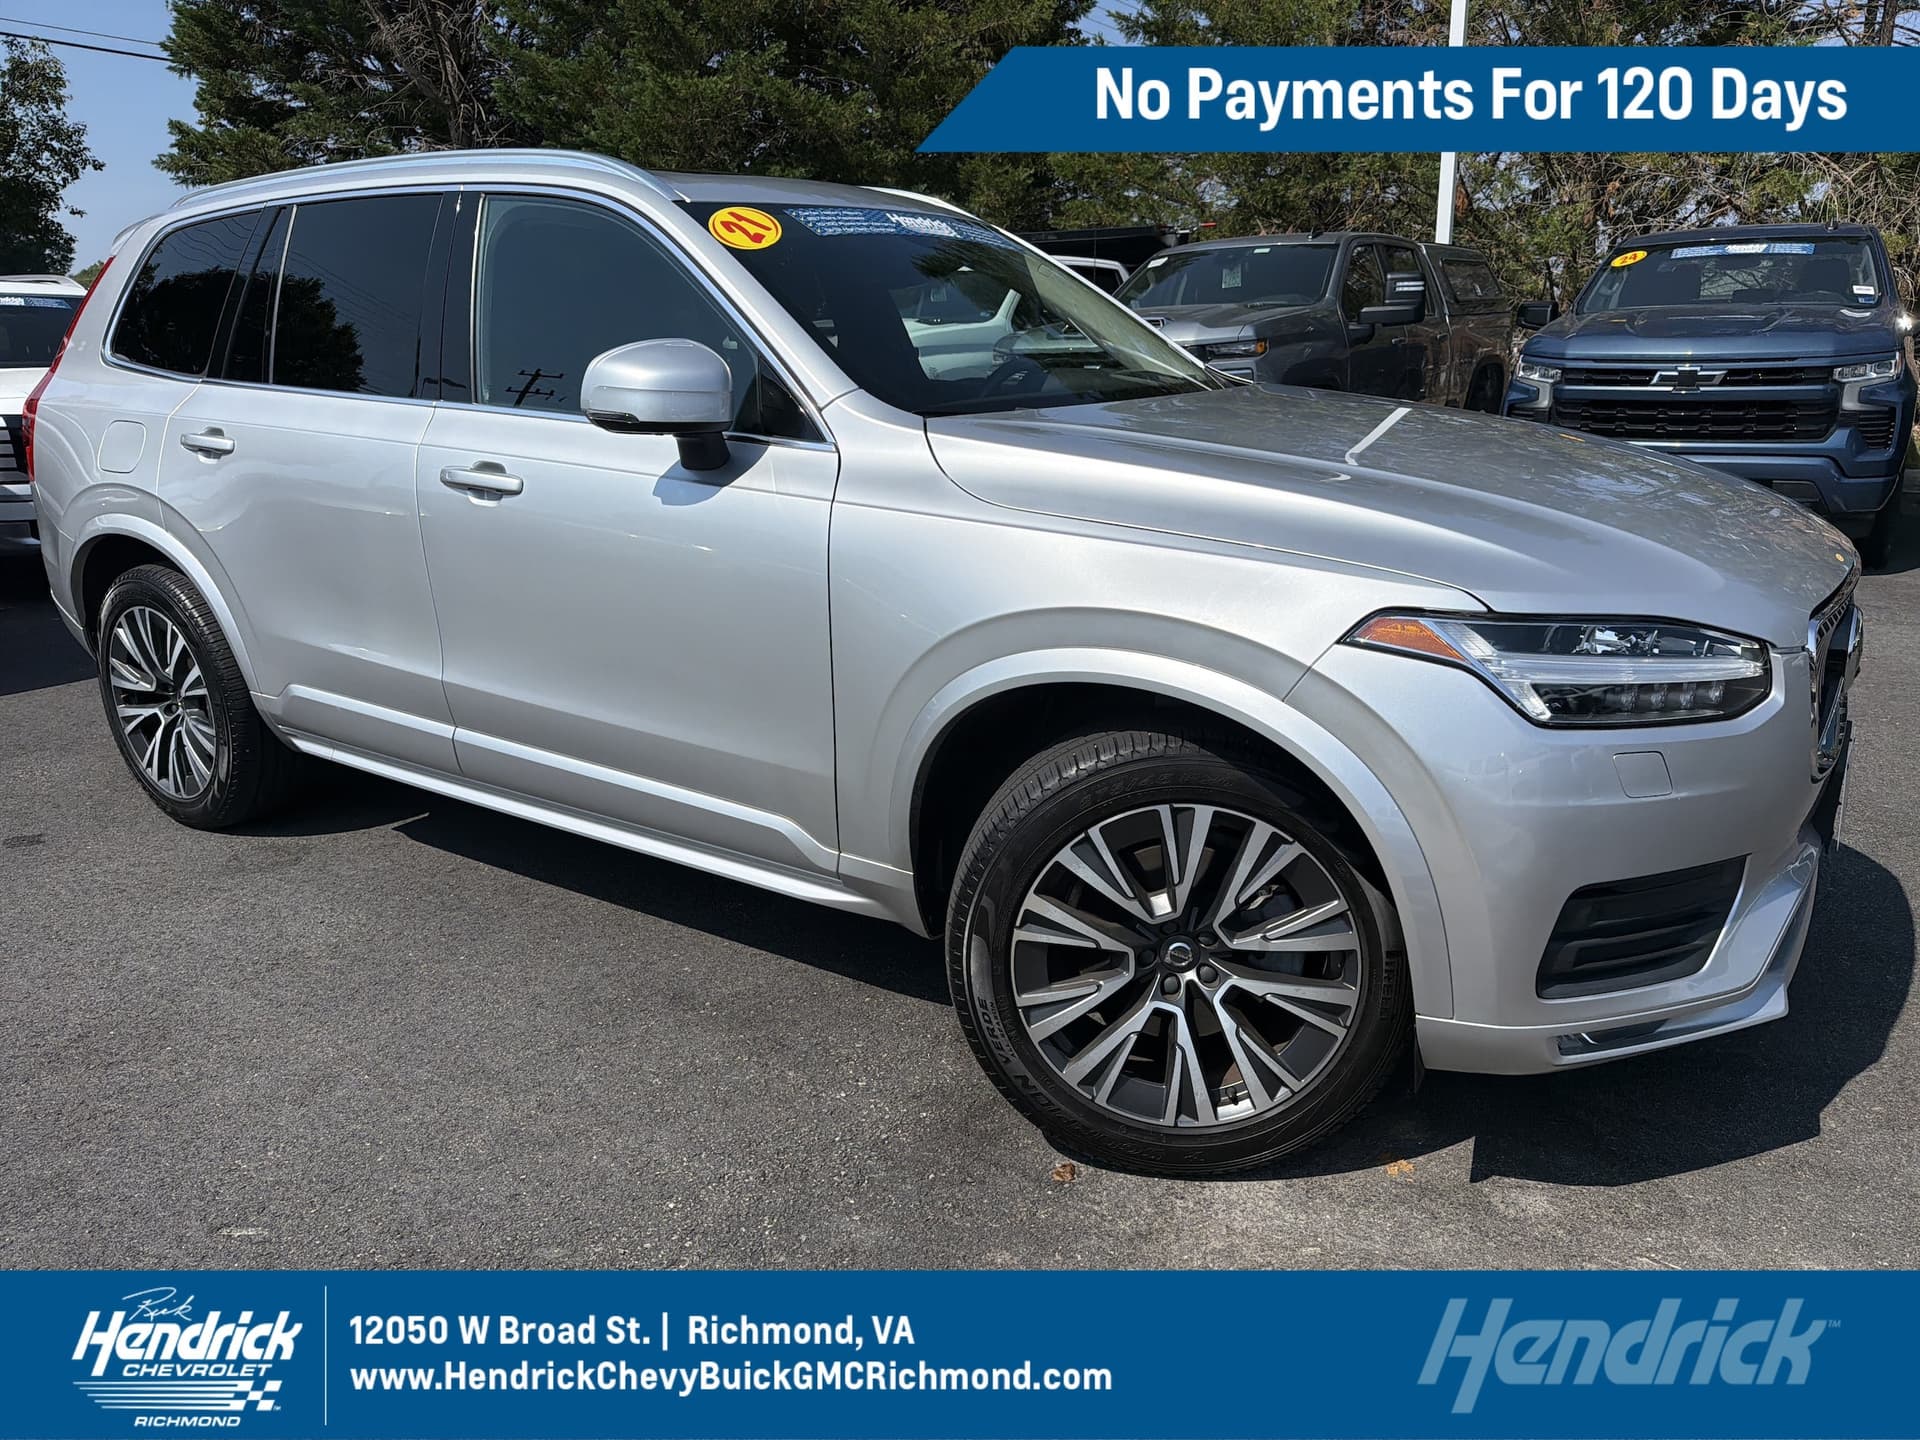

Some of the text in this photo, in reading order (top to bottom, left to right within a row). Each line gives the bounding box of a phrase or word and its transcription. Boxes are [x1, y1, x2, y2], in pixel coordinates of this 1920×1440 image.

[719, 210, 779, 244] 21
[1620, 252, 1639, 264] 24
[977, 996, 1011, 1064] VERDE
